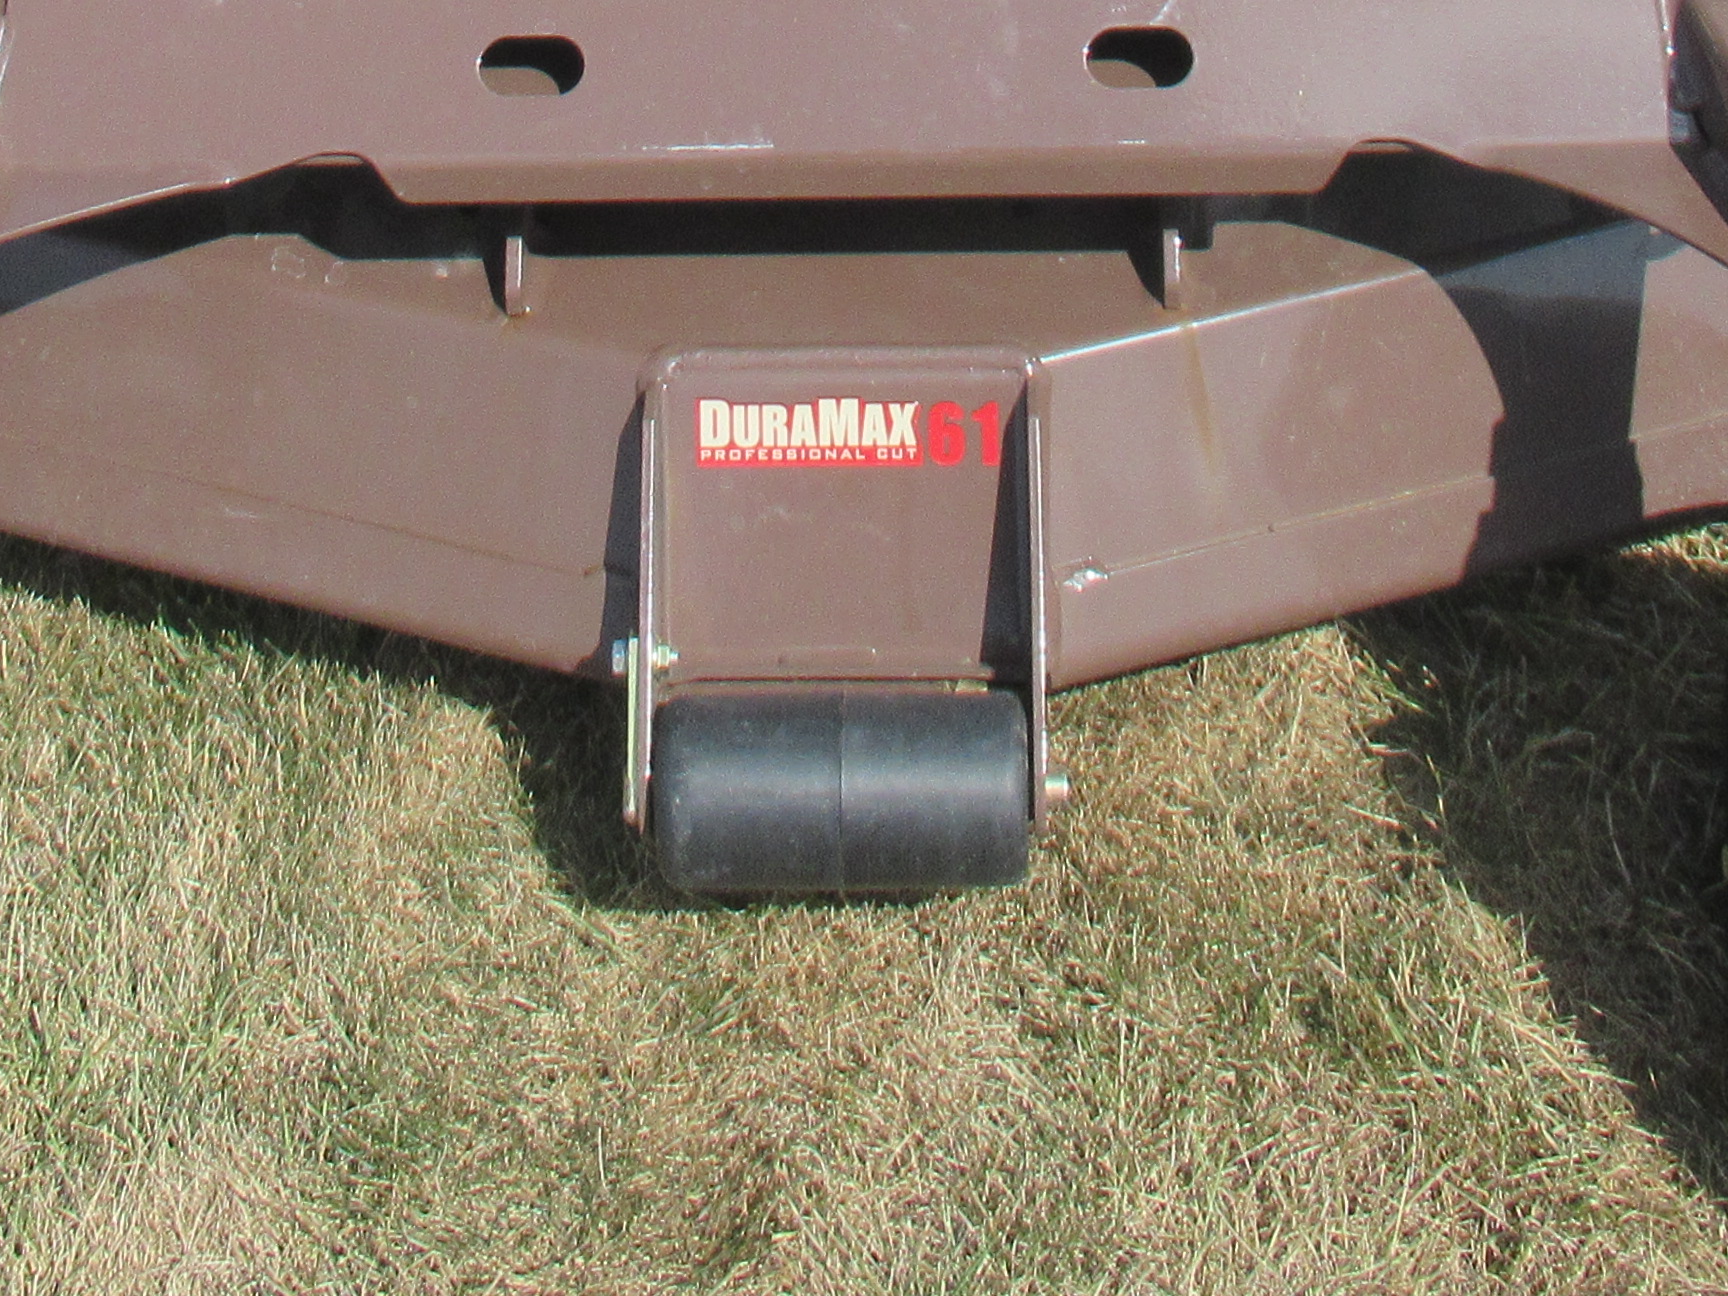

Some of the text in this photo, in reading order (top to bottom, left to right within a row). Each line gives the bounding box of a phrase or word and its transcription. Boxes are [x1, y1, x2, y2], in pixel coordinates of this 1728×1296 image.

[928, 400, 1000, 466] 61
[700, 447, 917, 461] PROFESSIONAL CUT
